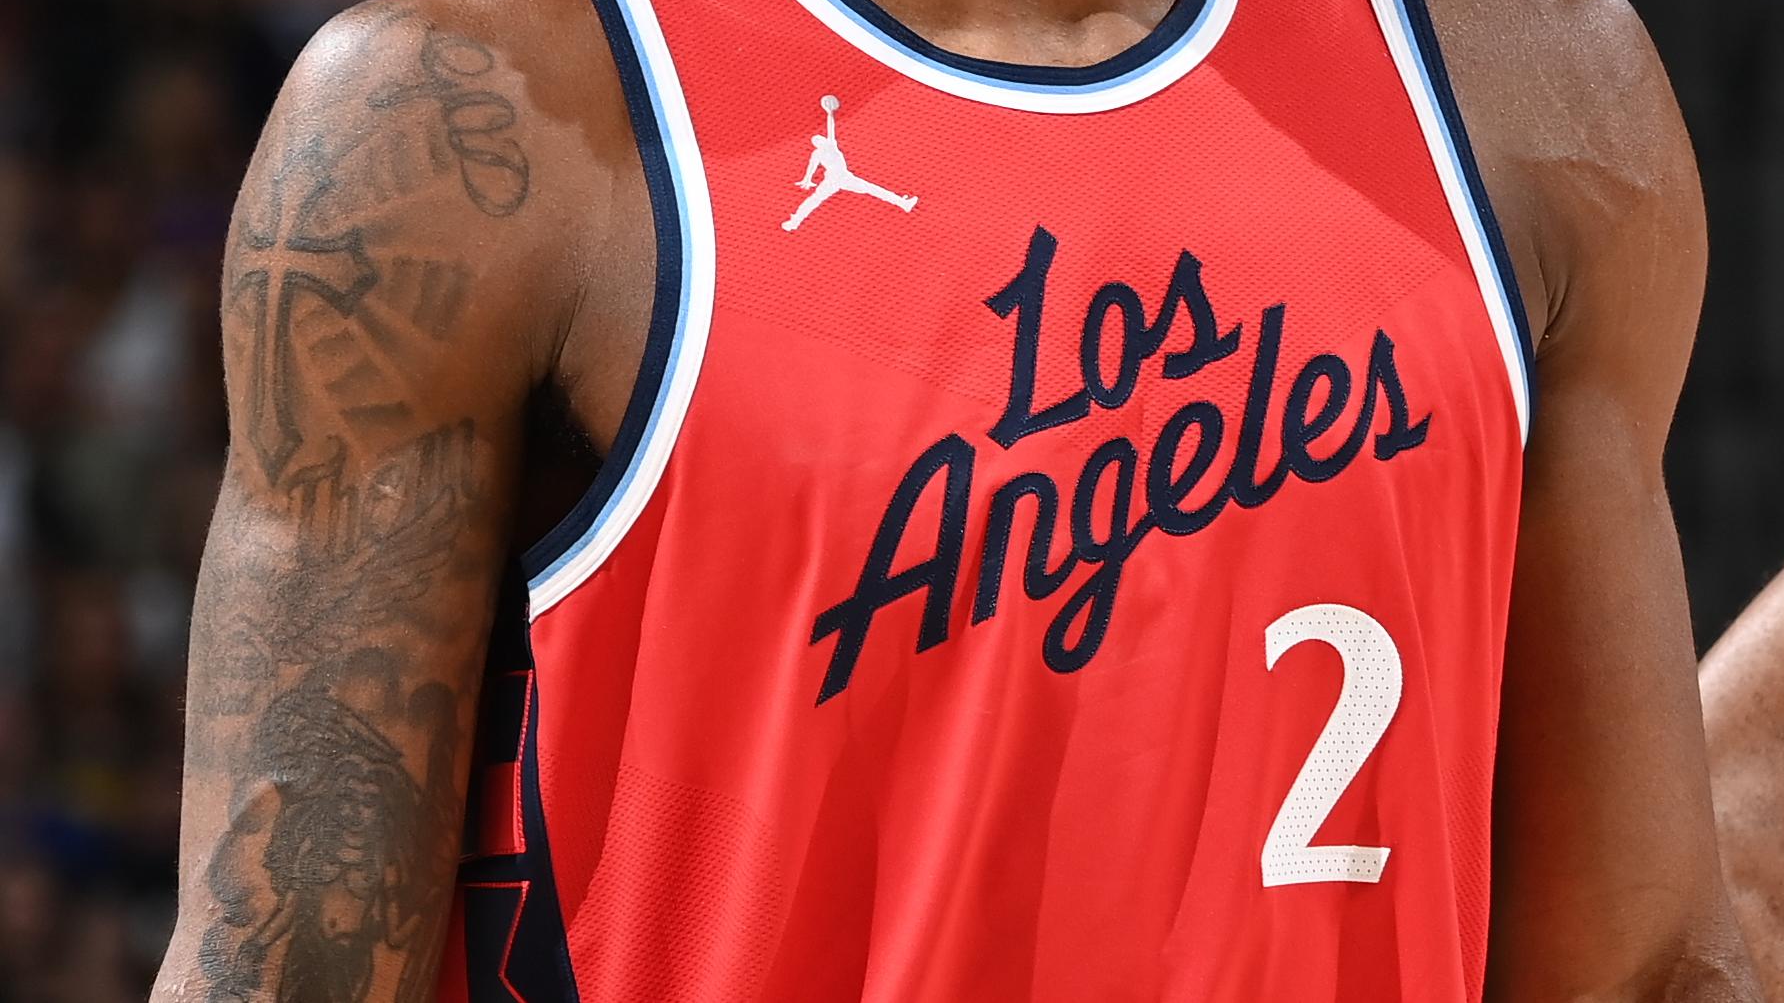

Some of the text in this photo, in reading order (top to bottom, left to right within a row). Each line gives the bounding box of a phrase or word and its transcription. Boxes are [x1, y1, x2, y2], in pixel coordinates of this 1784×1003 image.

[984, 225, 1243, 450] Los
[809, 302, 1432, 706] Angeles
[1261, 604, 1403, 888] 2
